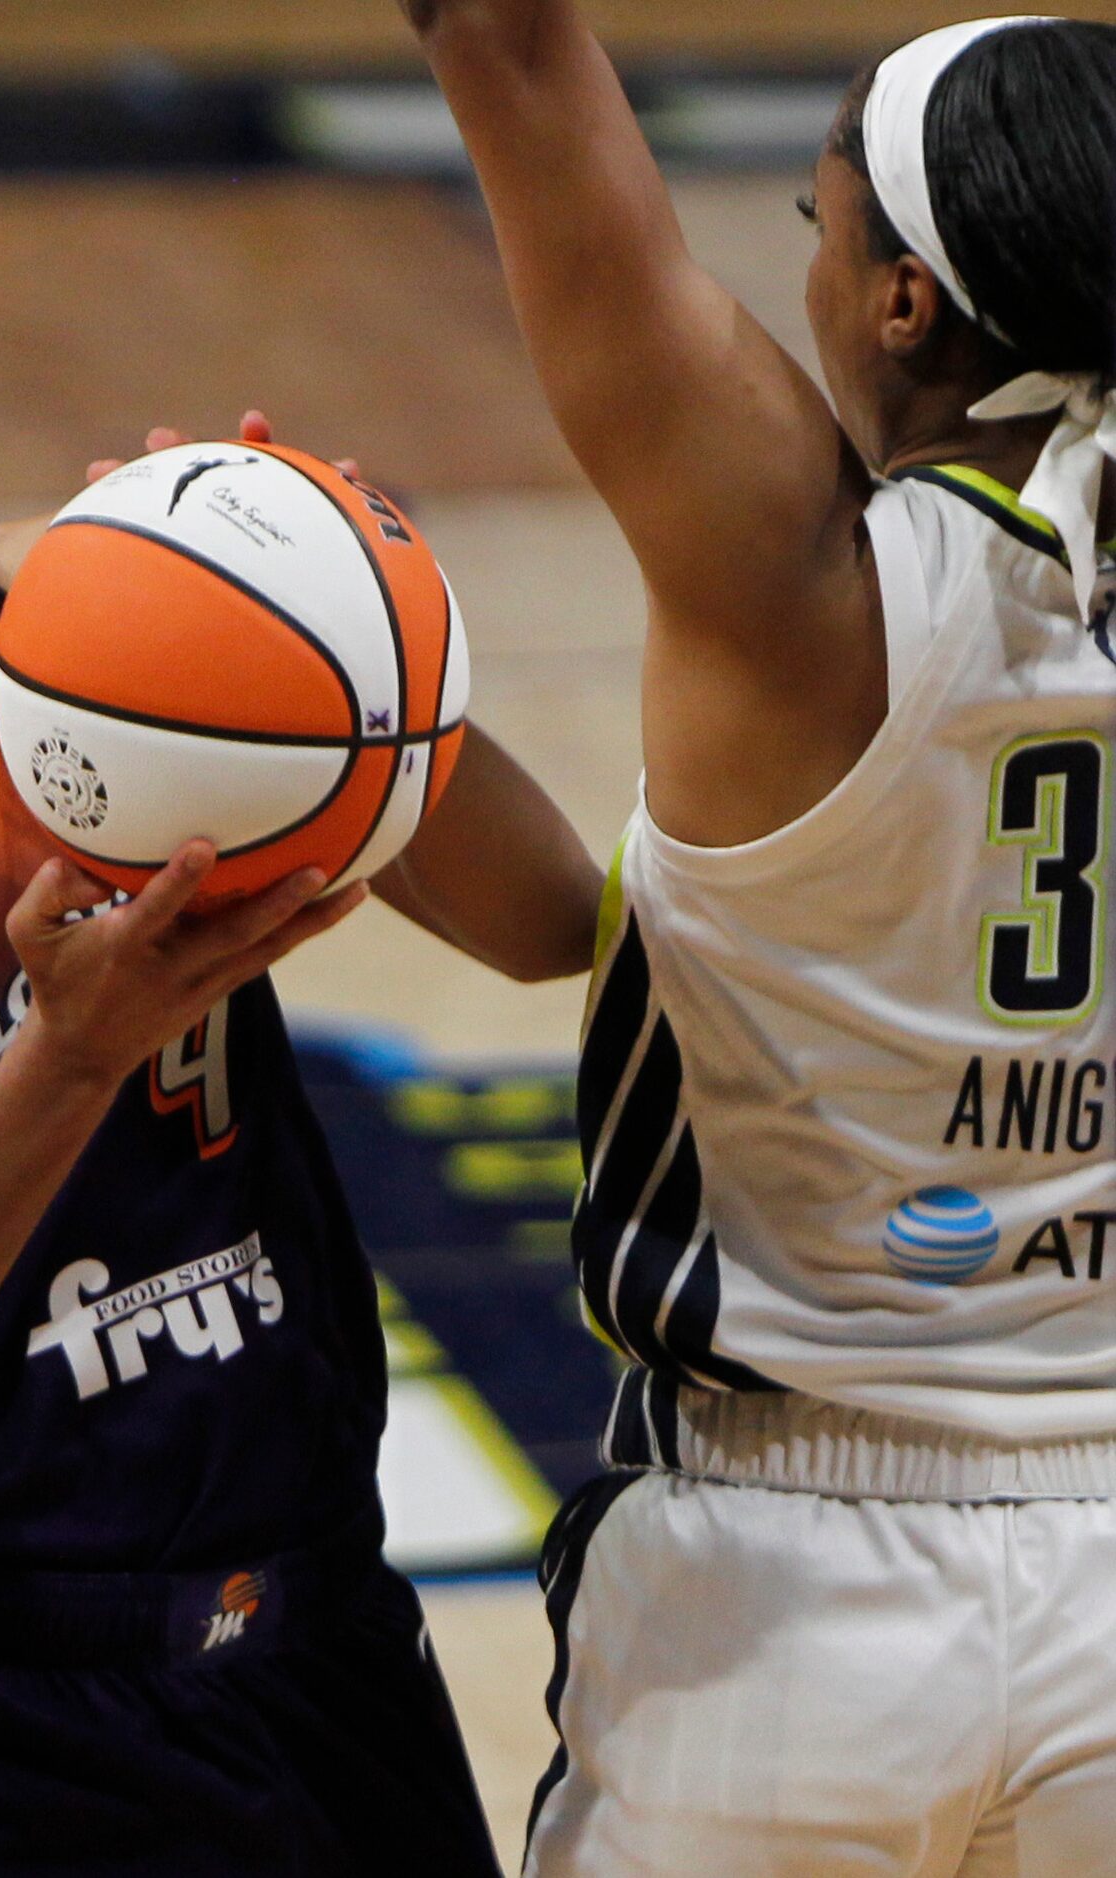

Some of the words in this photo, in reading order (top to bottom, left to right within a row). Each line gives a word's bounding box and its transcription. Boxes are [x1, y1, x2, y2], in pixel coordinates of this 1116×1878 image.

[980, 732, 1108, 1024] 3
[149, 993, 240, 1160] 4
[943, 1055, 1116, 1153] ANIG
[94, 1280, 167, 1323] FOOD
